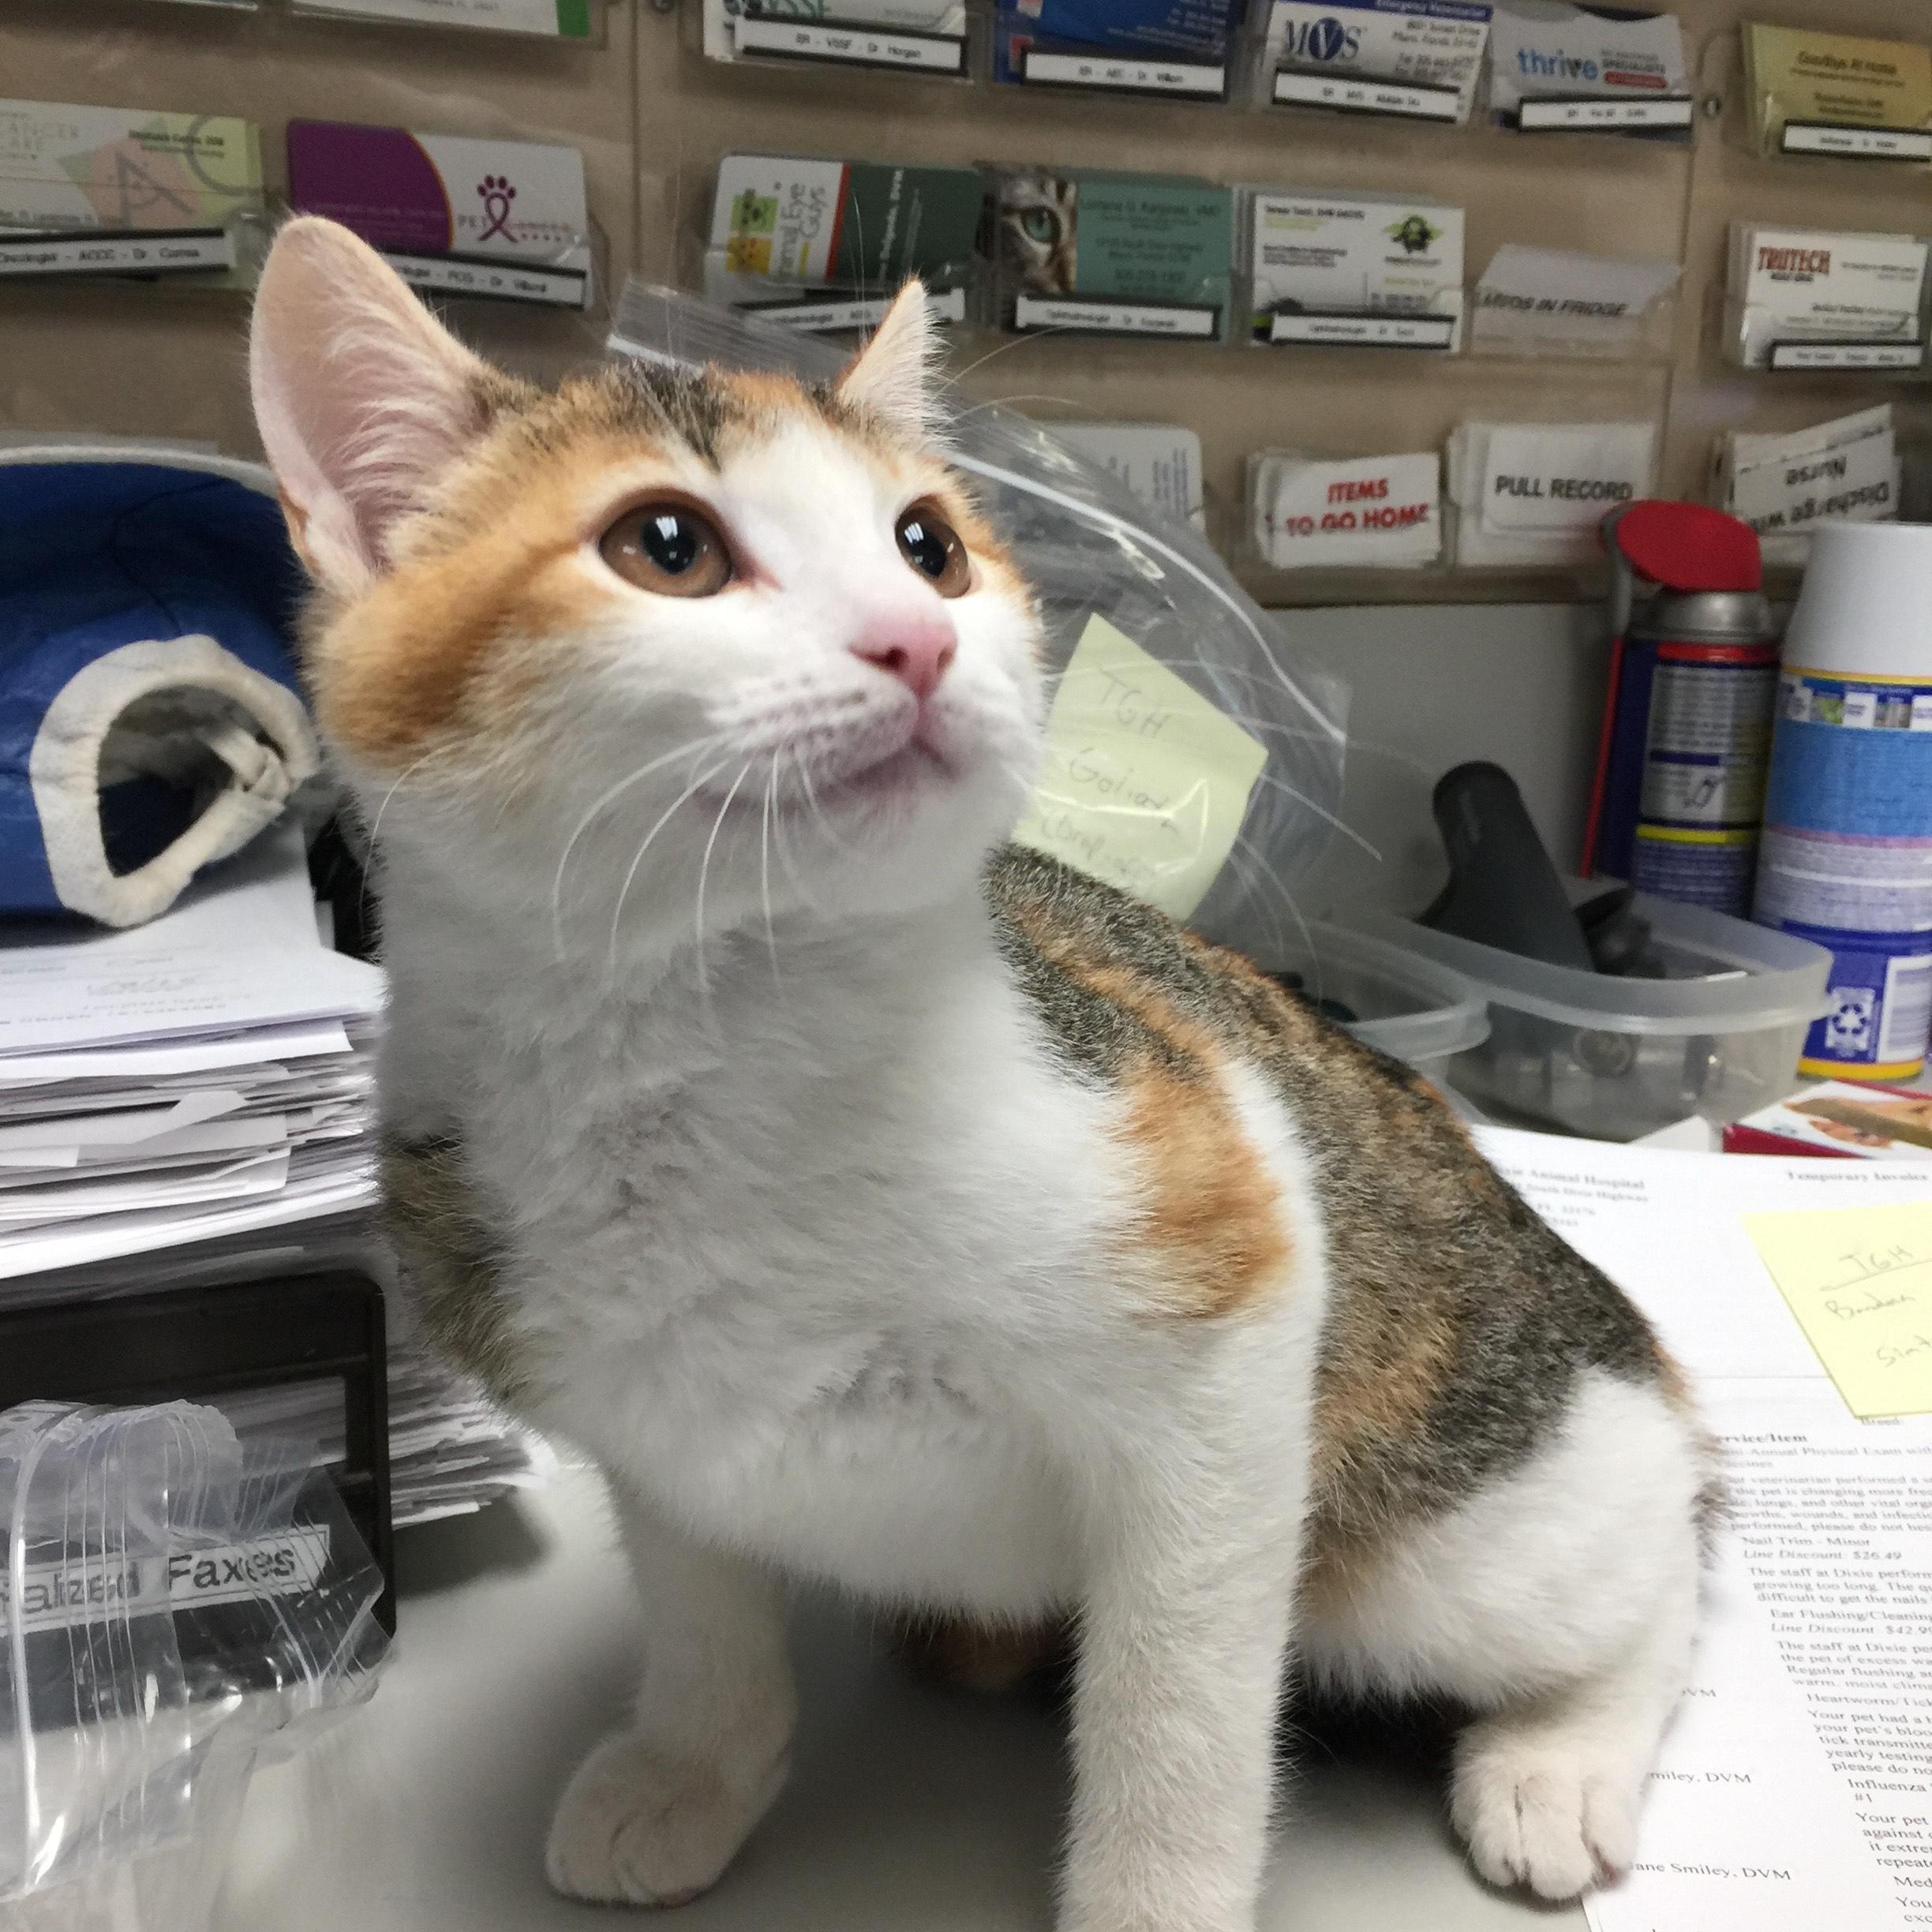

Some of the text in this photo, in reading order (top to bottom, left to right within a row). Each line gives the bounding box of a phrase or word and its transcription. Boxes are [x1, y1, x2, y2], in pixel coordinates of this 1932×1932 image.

[1517, 47, 1599, 80] thrive
[1327, 477, 1389, 504] ITEMS
[1496, 474, 1634, 501] PULL RECORD
[1286, 504, 1429, 537] TO GO HOME
[1780, 1567, 1812, 1578] staff
[1833, 1568, 1874, 1578] Dixie
[0, 1548, 296, 1618] alized Faxes
[1753, 1582, 1814, 1593] growing
[1757, 1592, 1816, 1603] difficult
[1839, 1595, 1861, 1605] get
[1865, 1594, 1888, 1604] the
[1892, 1594, 1928, 1604] nails
[1770, 1608, 1795, 1619] Ear
[1771, 1623, 1803, 1634] Line
[1777, 1640, 1805, 1651] The
[1810, 1642, 1843, 1652] staff
[1866, 1642, 1908, 1653] Dixie
[1780, 1653, 1804, 1663] the
[1808, 1655, 1832, 1664] pet
[1837, 1655, 1852, 1664] of
[1786, 1664, 1845, 1676] Regular
[1851, 1667, 1916, 1680] flushing
[1807, 1710, 1845, 1720] Your
[1850, 1713, 1875, 1724] pet
[1878, 1713, 1909, 1724] had
[1813, 1724, 1848, 1734] your
[1818, 1735, 1849, 1745] tick
[1825, 1749, 1874, 1762] yearly
[1831, 1761, 1883, 1773] please
[1888, 1764, 1909, 1774] do
[1704, 1772, 1752, 1784] DVM
[1848, 1778, 1927, 1793] Influenza
[1855, 1812, 1930, 1827] Your pet
[1862, 1827, 1924, 1840] against
[1869, 1840, 1882, 1852] it
[1740, 1867, 1792, 1881] DVM
